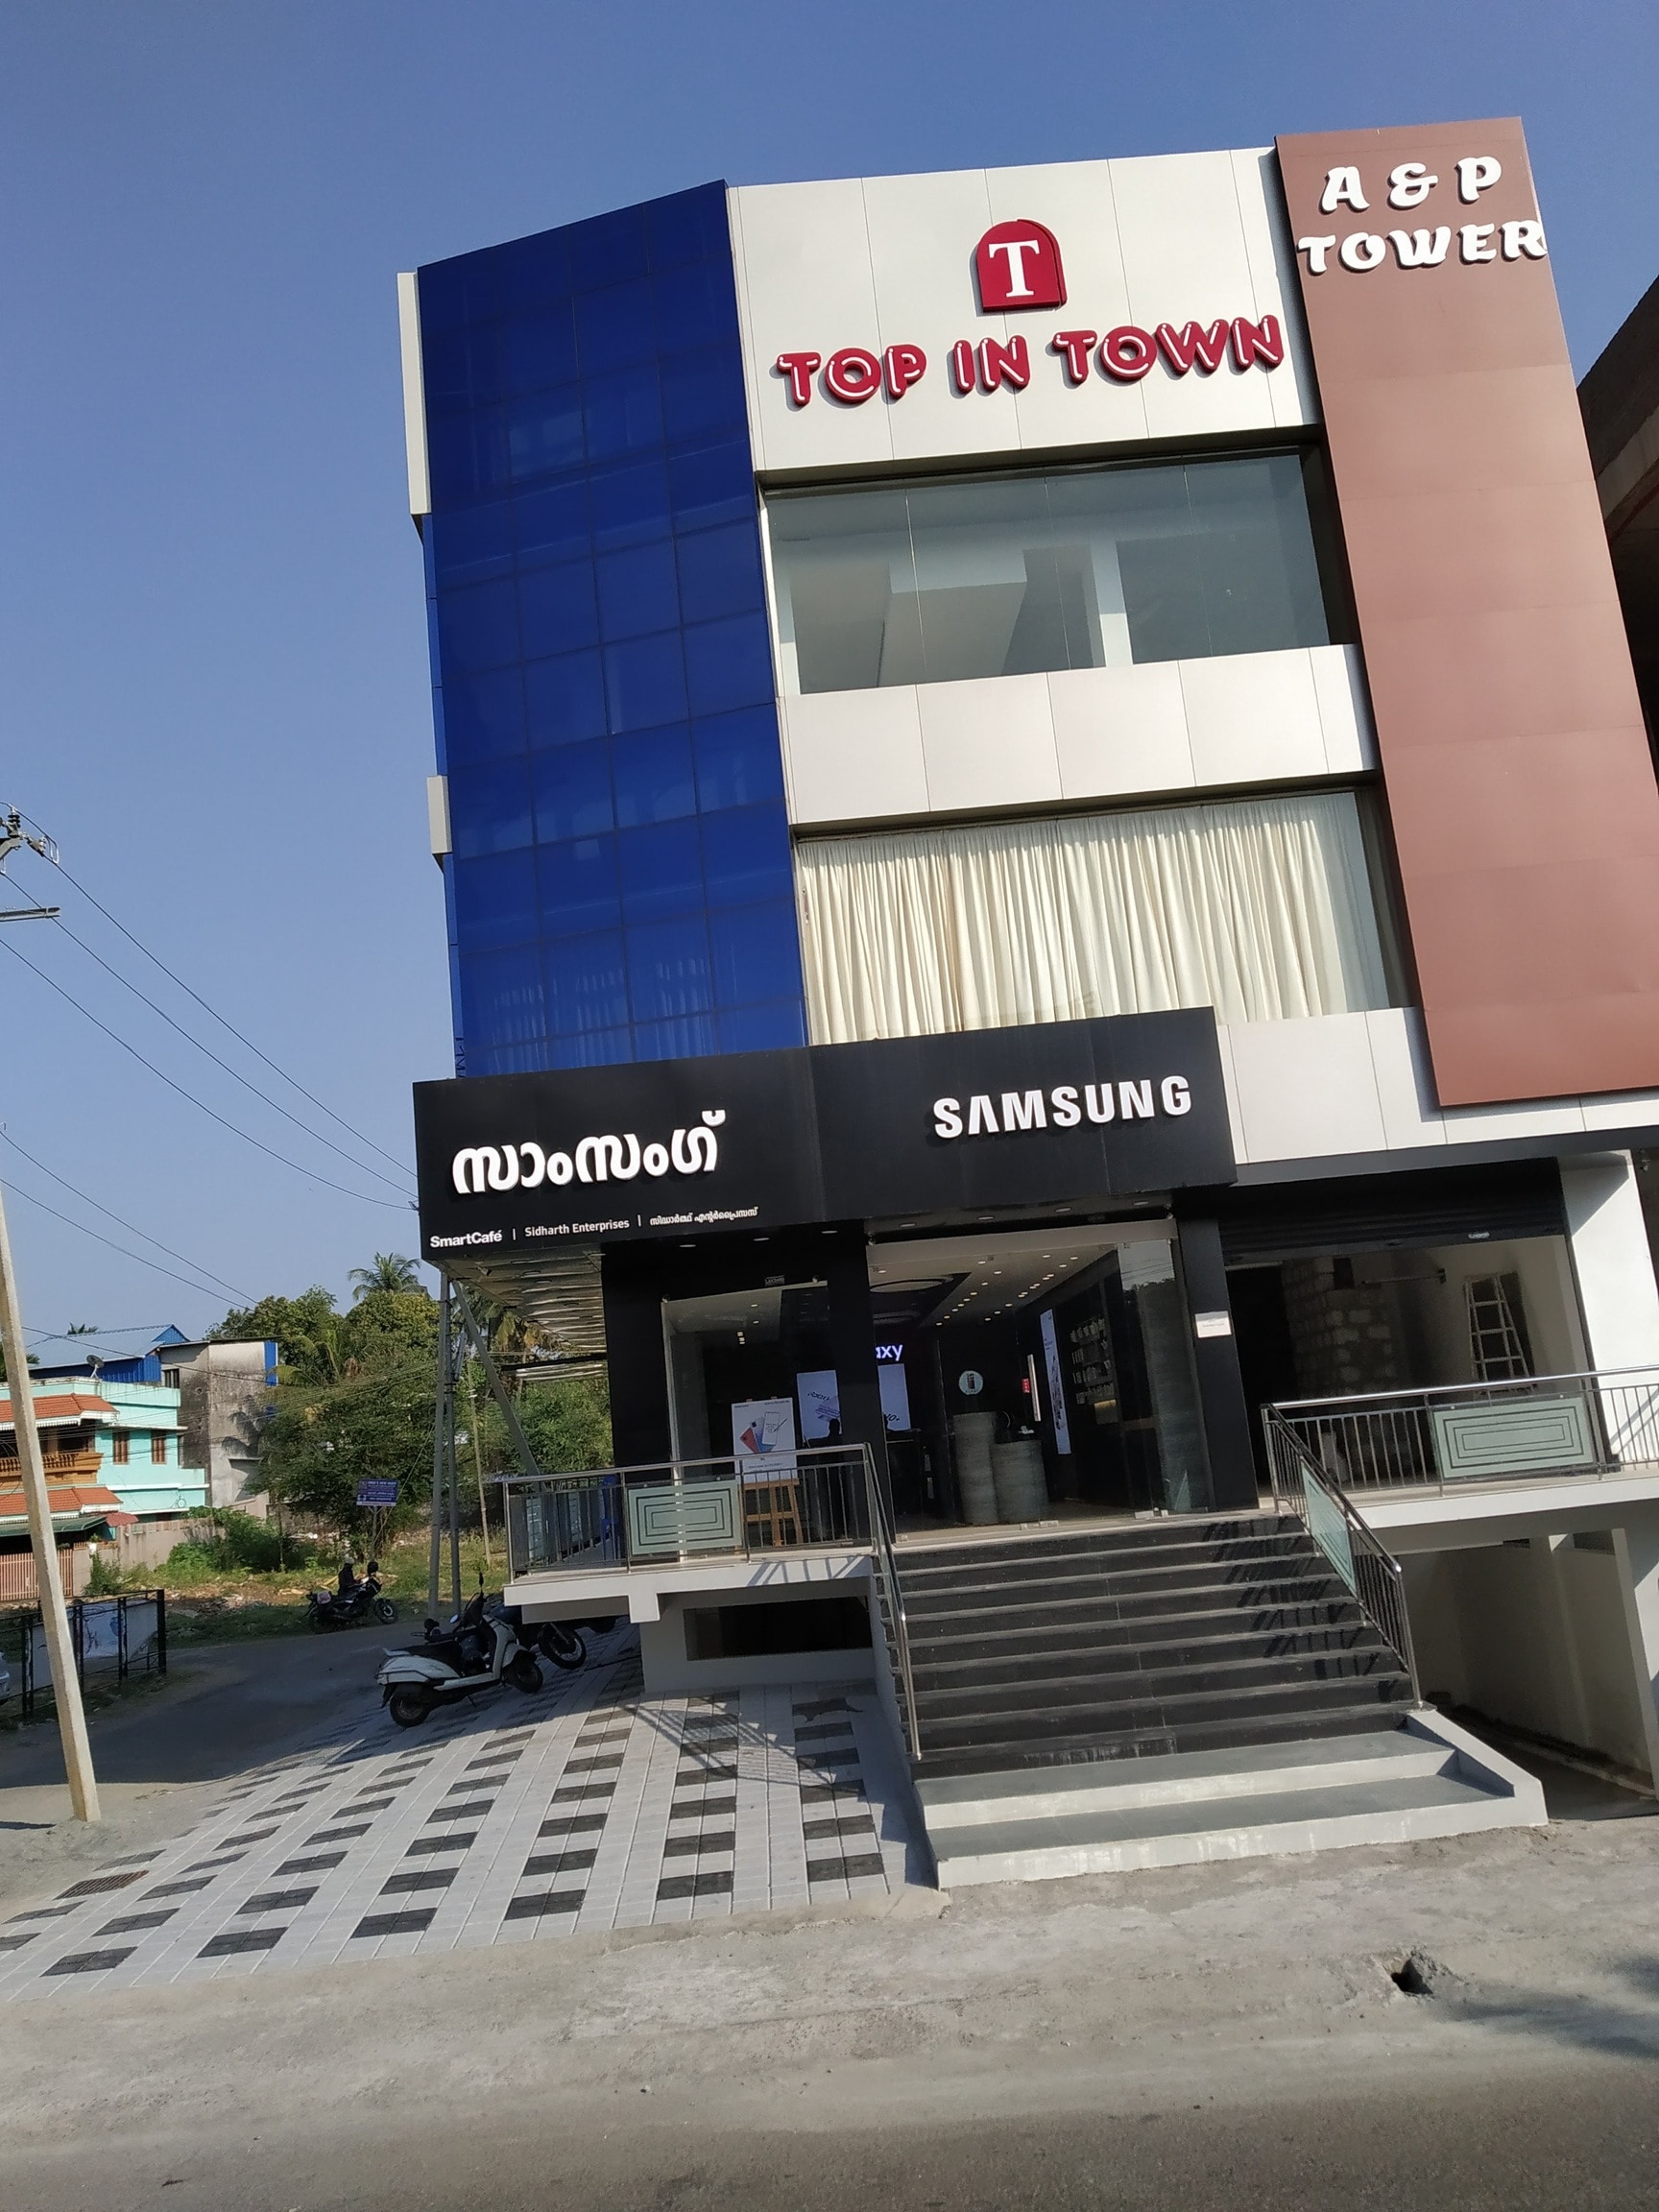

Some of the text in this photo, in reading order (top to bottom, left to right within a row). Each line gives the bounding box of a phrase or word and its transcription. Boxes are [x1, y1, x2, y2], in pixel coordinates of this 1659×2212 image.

[1319, 156, 1502, 214] A & P
[988, 239, 1040, 298] T
[1296, 219, 1548, 276] TOWER
[776, 314, 1285, 407] TOP IN TOWN
[932, 1074, 1192, 1140] SAMSUNG
[451, 1109, 727, 1194] സാംസംഗ്
[429, 1218, 630, 1249] SmartCafé Sidharth Enterprises
